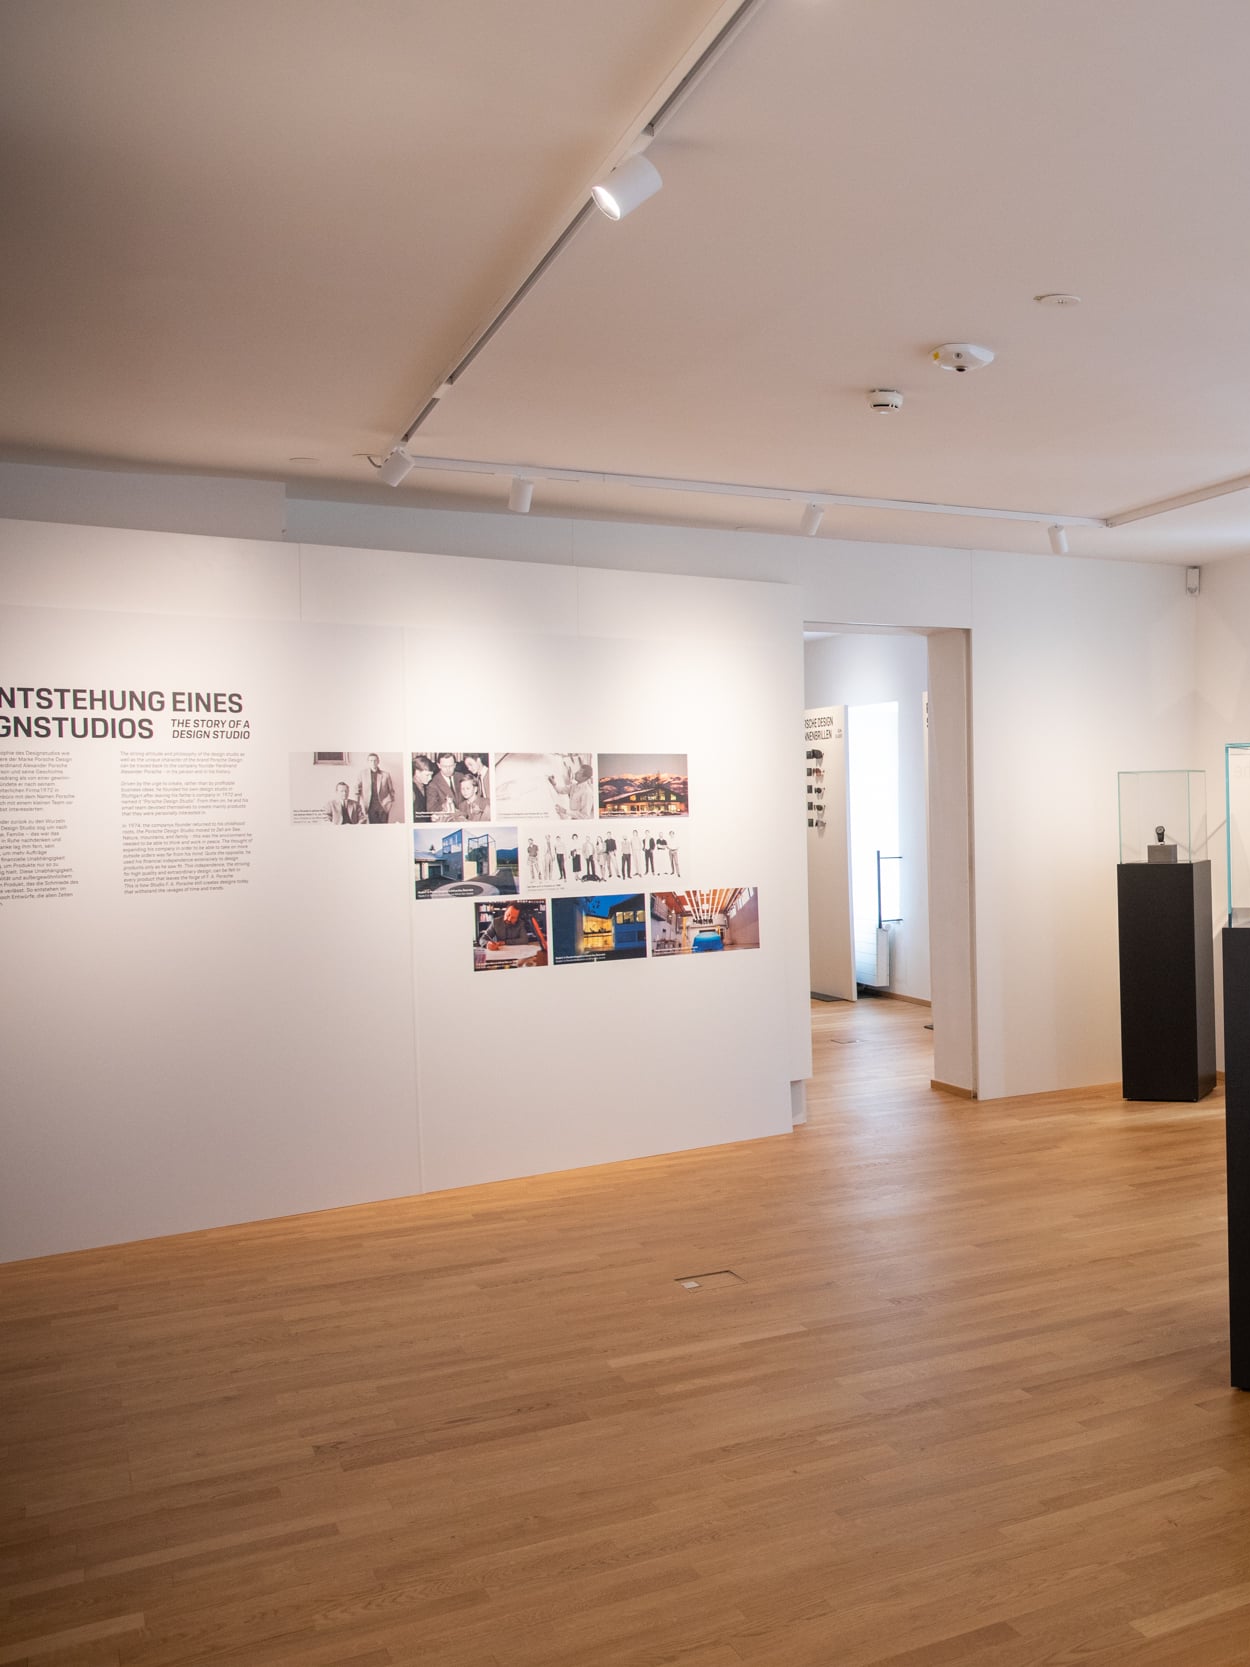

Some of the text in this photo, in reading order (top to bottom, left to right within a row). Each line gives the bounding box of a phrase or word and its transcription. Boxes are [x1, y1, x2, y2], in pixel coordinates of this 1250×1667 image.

[0, 687, 243, 713] NTSTEHUNG EINES
[0, 715, 154, 739] GNSTUDIOS
[171, 719, 250, 728] THE STORY OF A
[172, 729, 250, 739] DESIGN STUDIO
